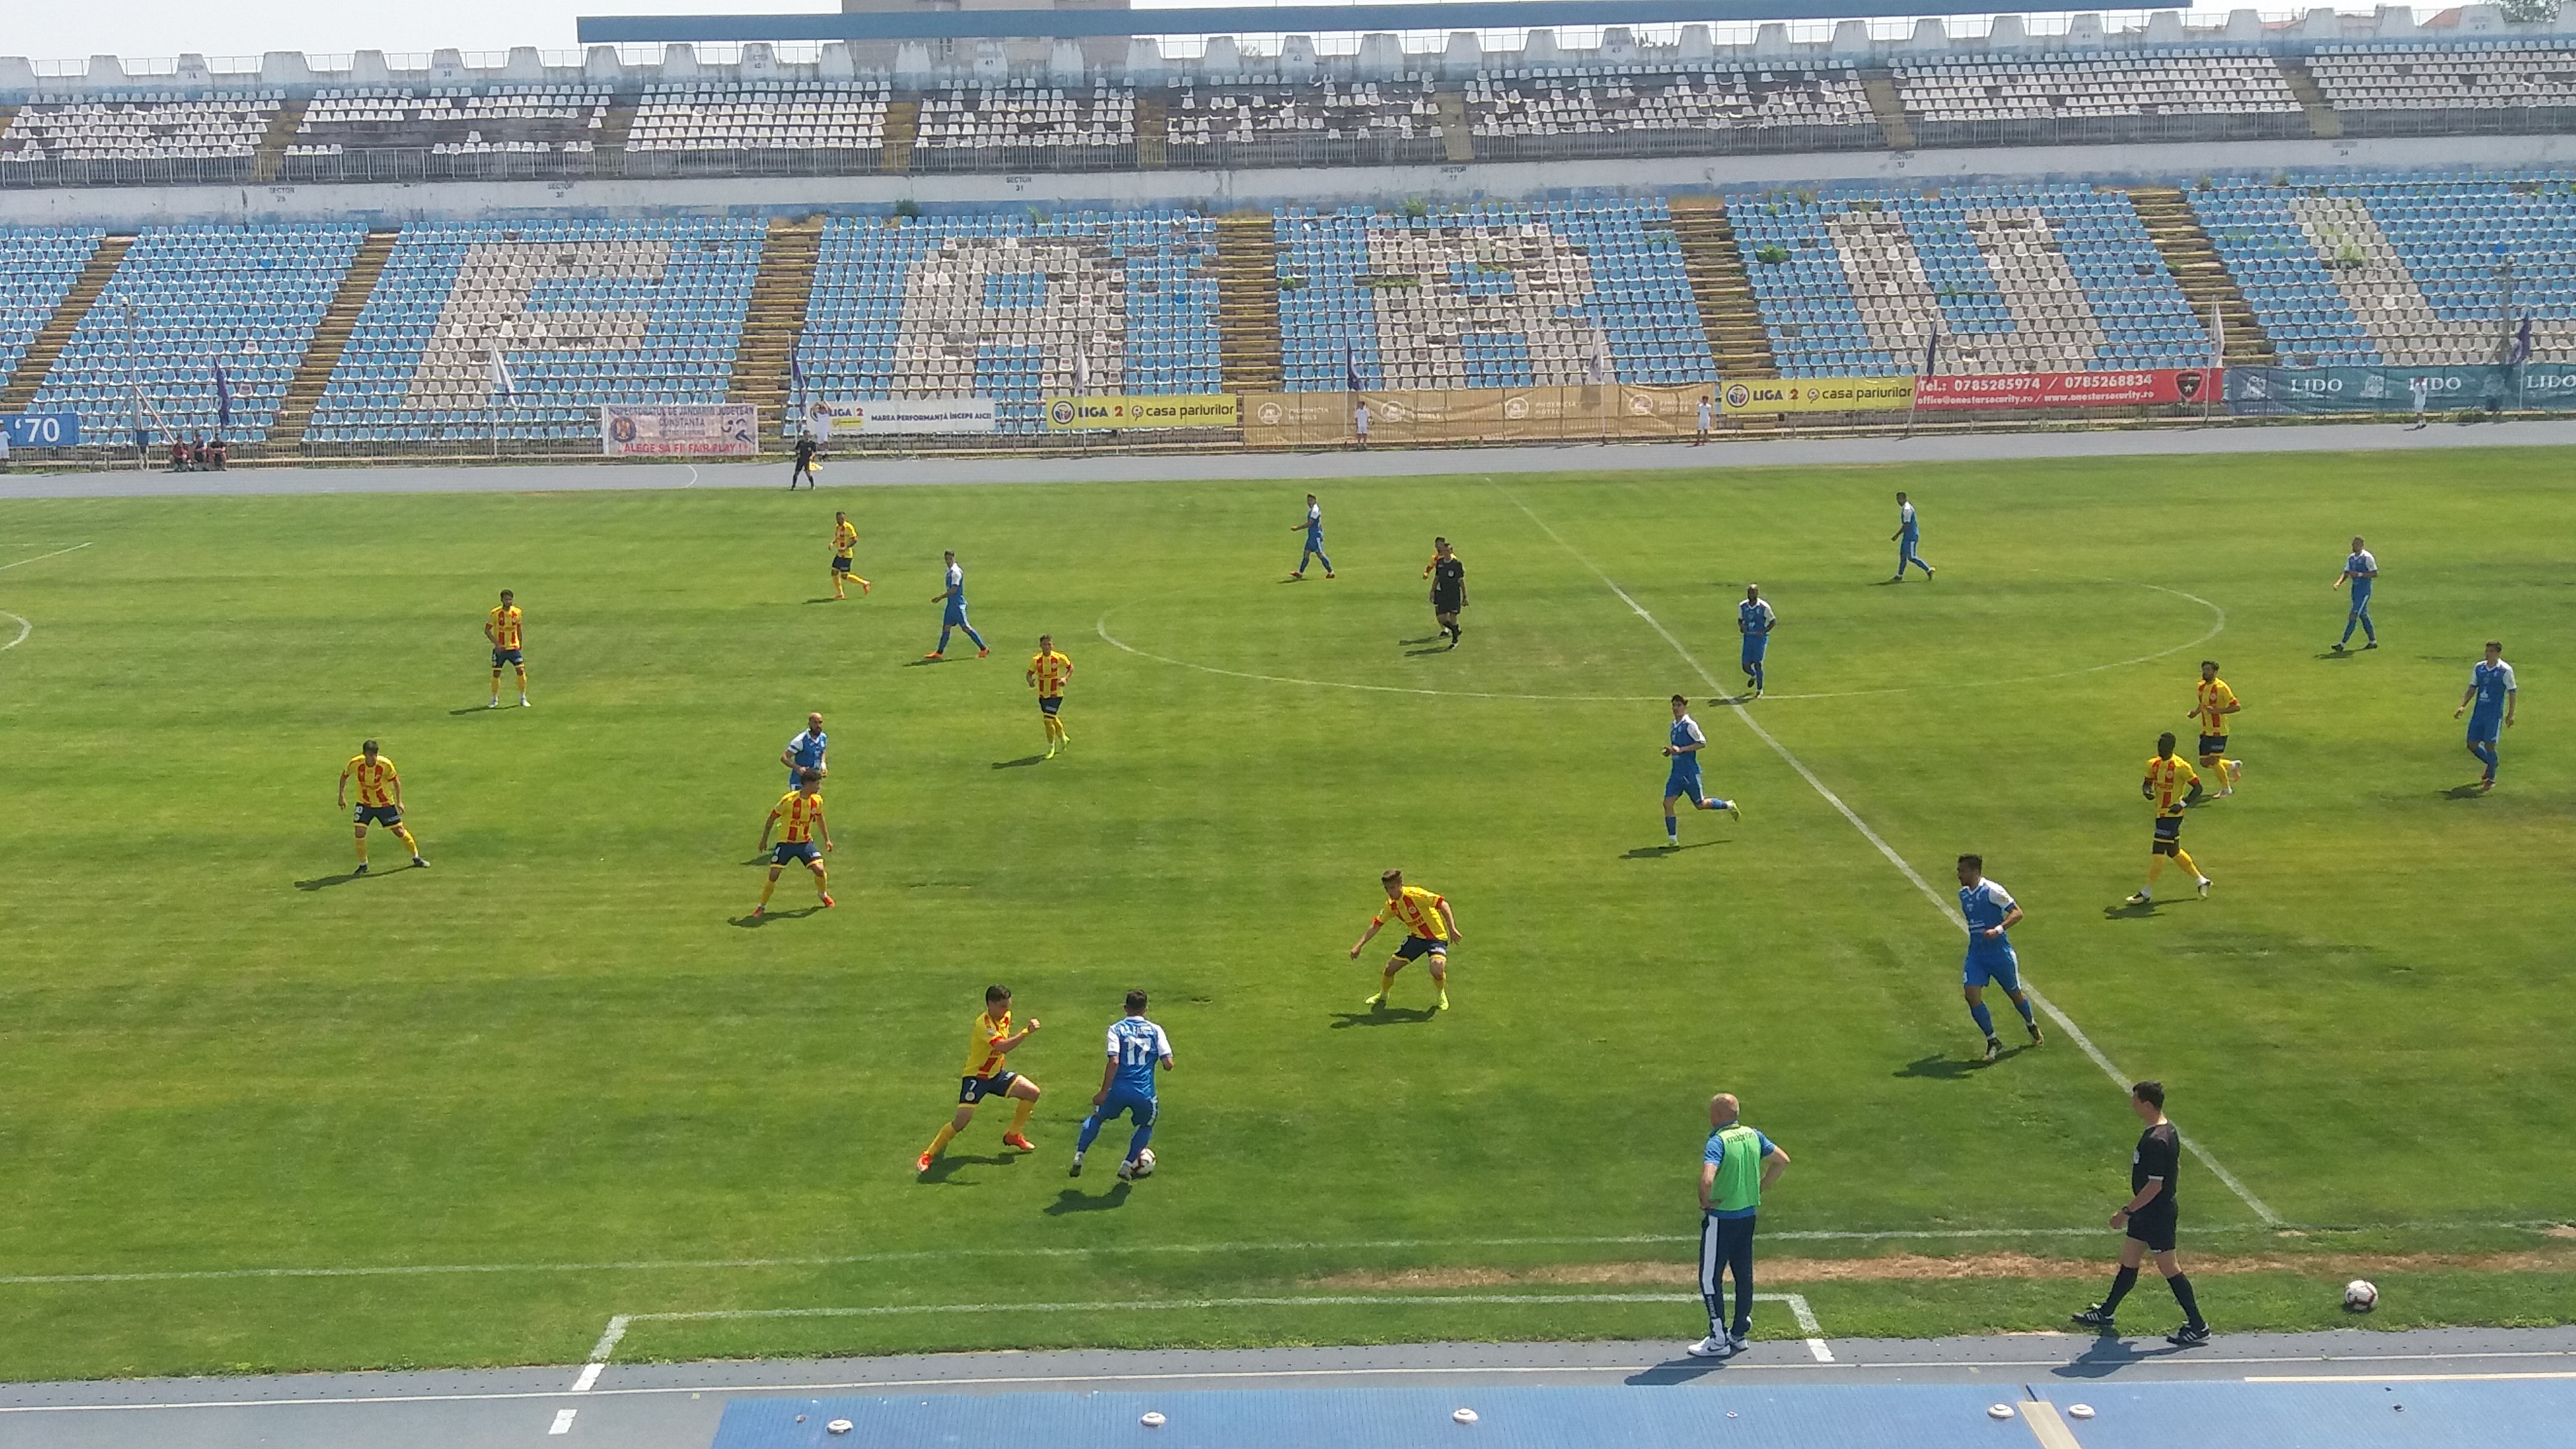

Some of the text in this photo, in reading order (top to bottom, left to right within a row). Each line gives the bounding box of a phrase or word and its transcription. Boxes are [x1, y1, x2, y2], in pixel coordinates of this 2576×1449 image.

[1954, 378, 2041, 391] 0785285974
[2065, 374, 2152, 388] 0785268834
[2290, 378, 2343, 392] LIDO
[2526, 374, 2576, 388] LIDO
[1753, 386, 1913, 402] LIGA 2 casa pariurilor
[668, 407, 678, 416] DE
[829, 407, 864, 416] LIGA 2
[1078, 404, 1234, 419] LIGA 2 casa pariurilor
[624, 443, 655, 452] ALEGE
[688, 443, 710, 453] FAIR
[713, 443, 735, 452] PLAY
[1124, 1037, 1152, 1065] 17
[970, 1079, 977, 1091] 7
